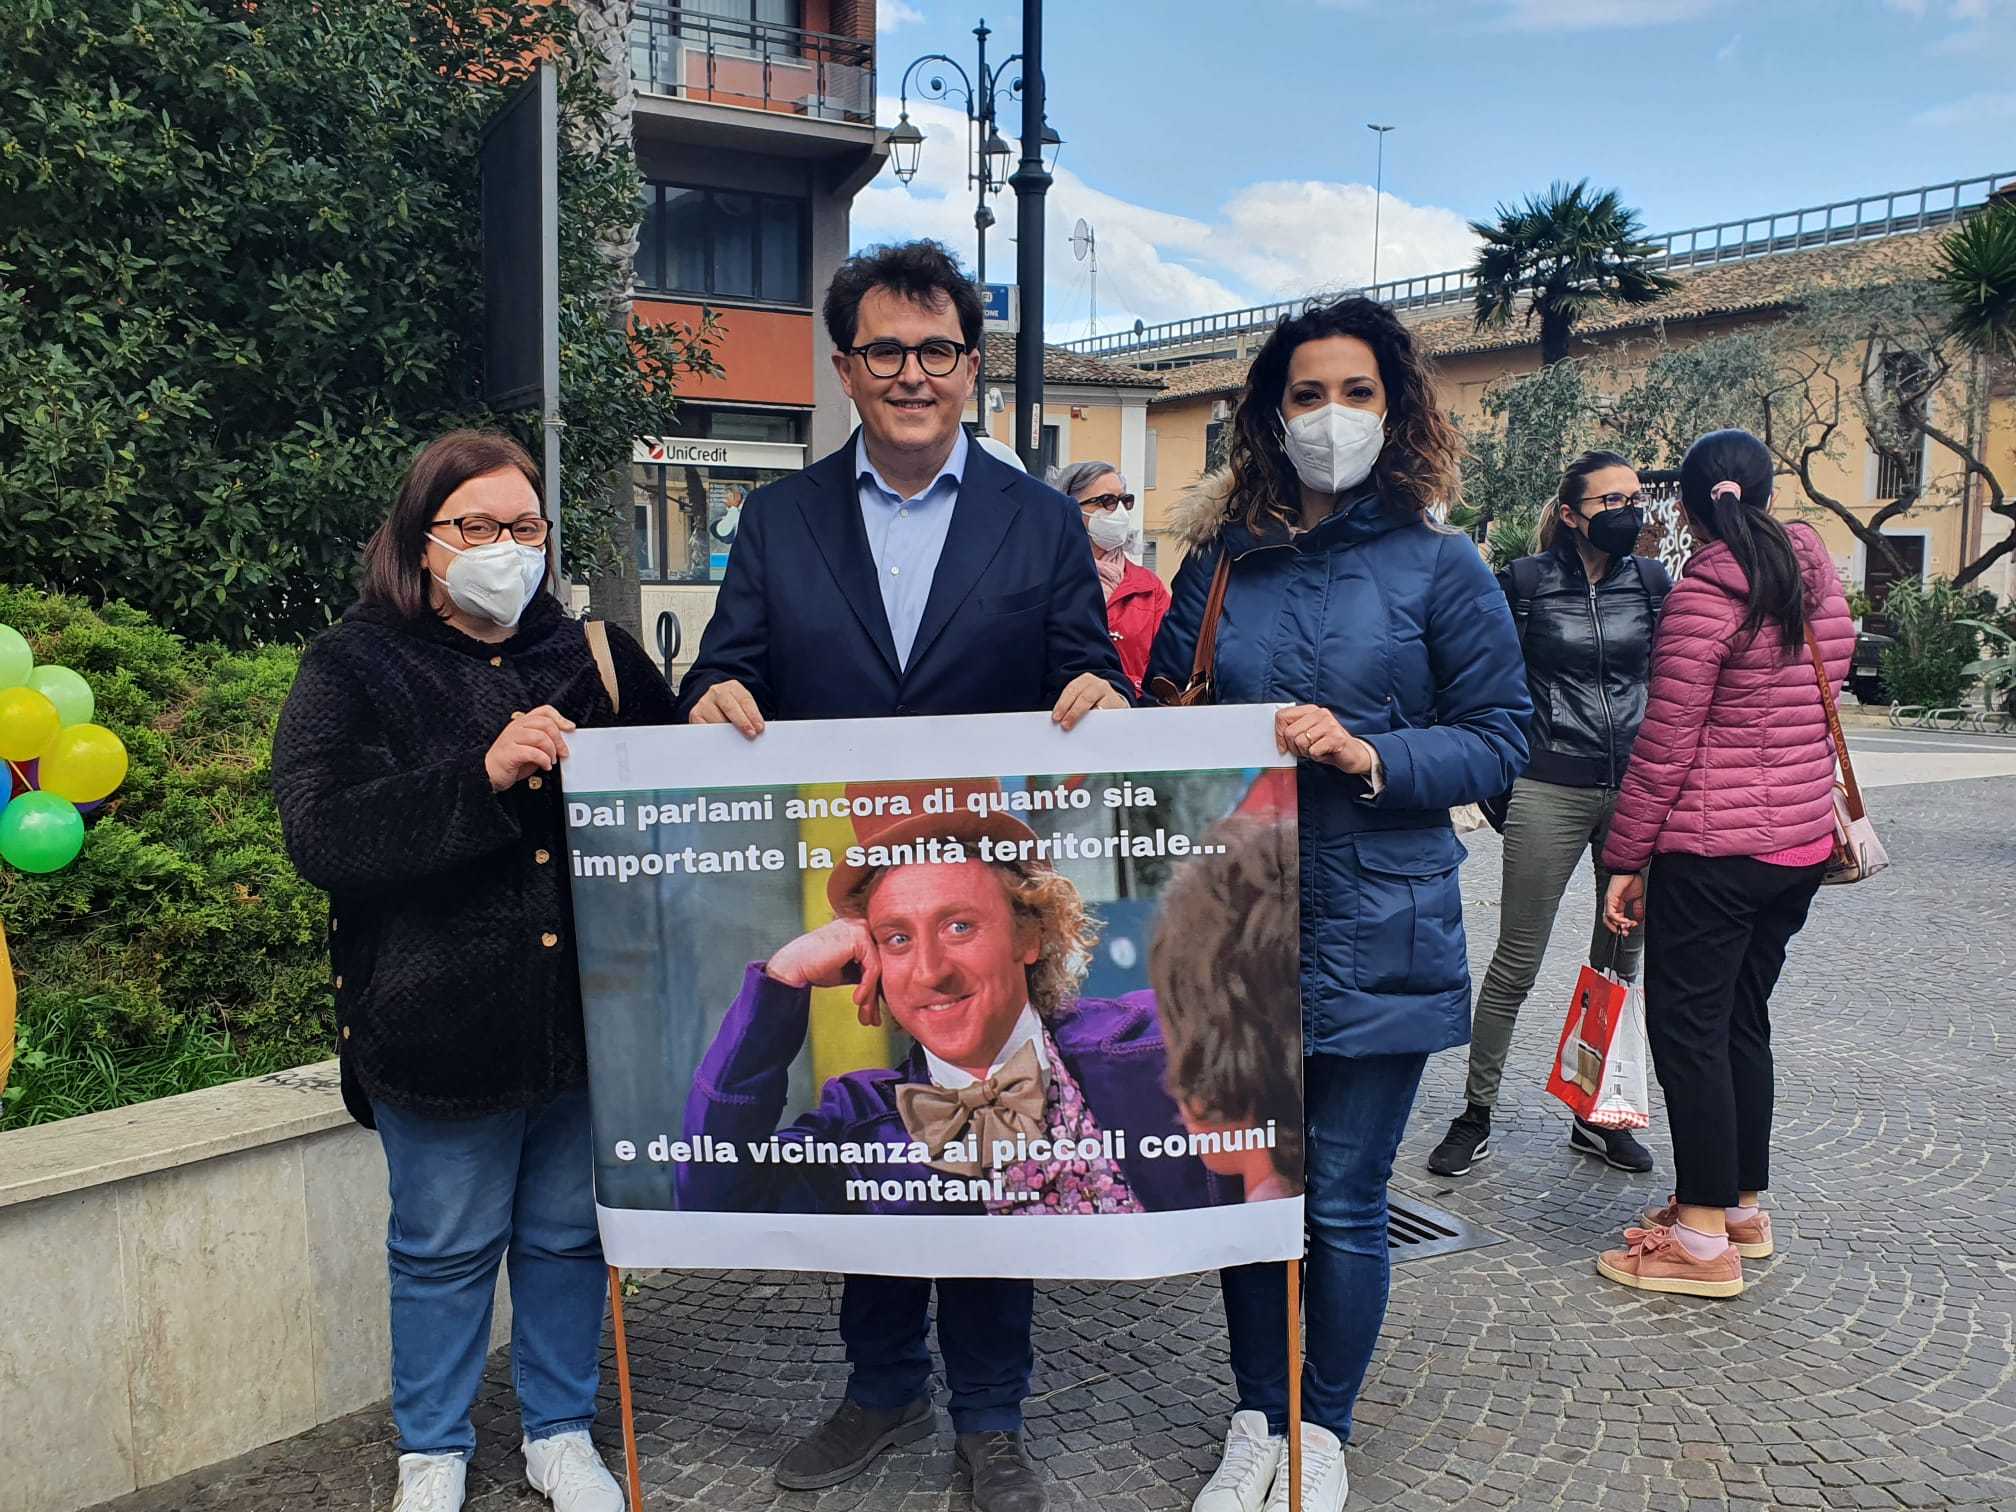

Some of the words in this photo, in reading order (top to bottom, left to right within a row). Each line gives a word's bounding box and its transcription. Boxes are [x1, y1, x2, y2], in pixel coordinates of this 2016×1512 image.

[666, 445, 728, 462] UniCredit
[1831, 716, 1850, 770] MILANO
[568, 800, 626, 828] Dai
[637, 794, 774, 831] parlami
[784, 795, 912, 820] ancora
[922, 787, 955, 813] di
[966, 784, 1091, 818] quanto
[1102, 781, 1157, 809] sia
[572, 845, 786, 883] importante
[798, 842, 834, 869] la
[845, 836, 967, 867] sanità
[978, 828, 1226, 864] territoriale...
[614, 1139, 637, 1161] e
[647, 1134, 739, 1164] della
[747, 1136, 931, 1164] vicinanza
[943, 1130, 979, 1163] ai
[992, 1129, 1127, 1167] piccoli
[1138, 1119, 1277, 1158] comuni
[845, 1173, 1040, 1202] montani...
